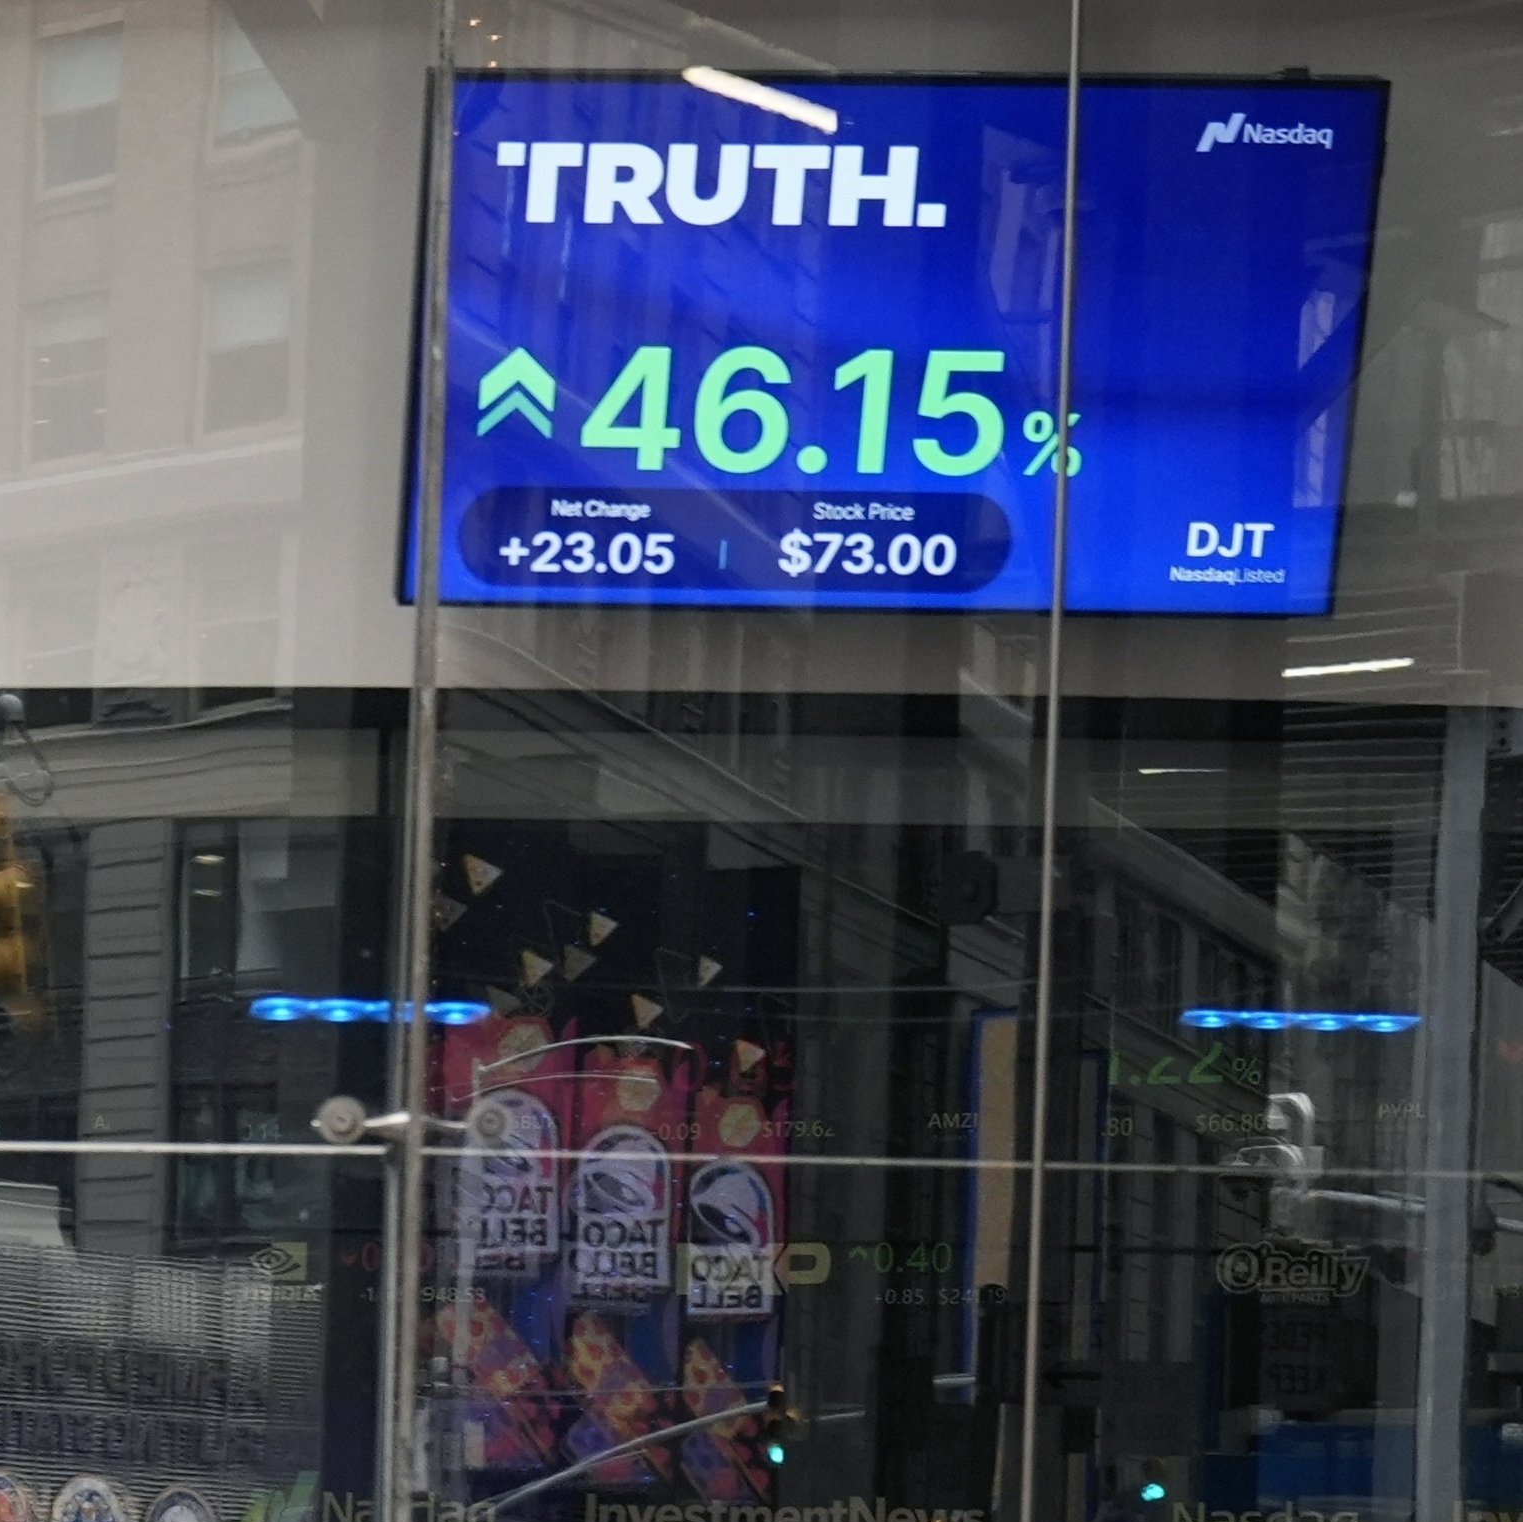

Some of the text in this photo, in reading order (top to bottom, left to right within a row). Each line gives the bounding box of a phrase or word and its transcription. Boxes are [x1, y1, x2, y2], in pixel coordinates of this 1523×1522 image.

[1242, 121, 1334, 151] Nasdaq
[496, 141, 947, 229] TRUTH.
[551, 499, 652, 522] Net Change
[812, 501, 915, 521] Stock Price
[498, 532, 676, 577] +23.05
[777, 529, 956, 578] $73.00
[1186, 521, 1275, 559] DJT
[1217, 1242, 1366, 1293] O'Reilly
